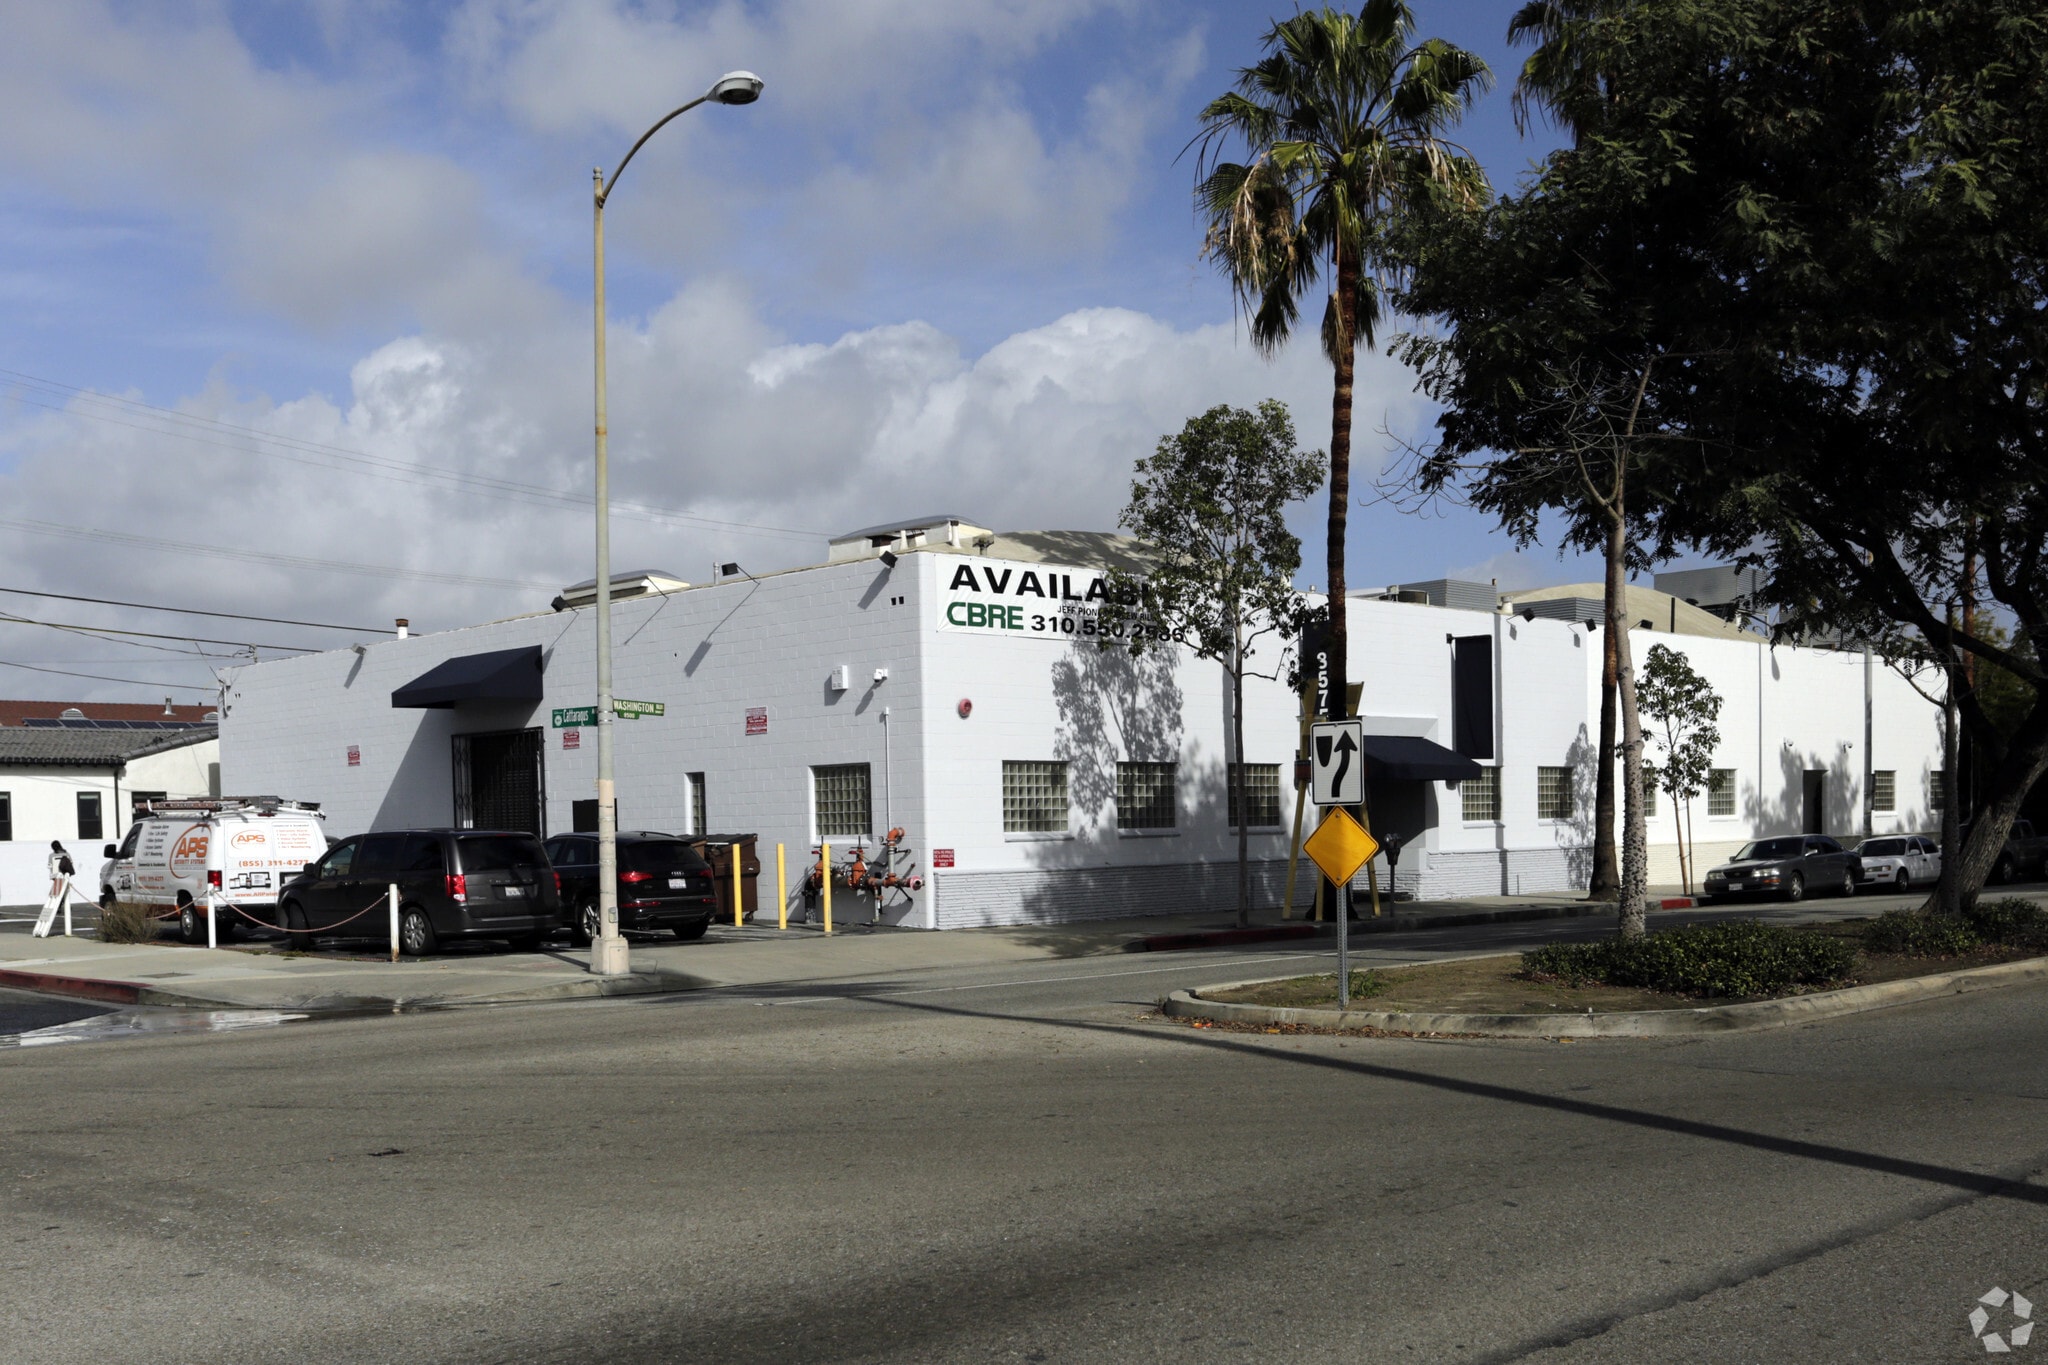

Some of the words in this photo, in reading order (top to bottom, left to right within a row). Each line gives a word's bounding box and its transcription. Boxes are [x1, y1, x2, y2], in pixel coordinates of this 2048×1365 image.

[949, 563, 1183, 611] AVAILAB
[946, 601, 1025, 631] CBRE
[1057, 605, 1076, 615] JEFF
[613, 699, 655, 714] WASHINGTON
[236, 834, 266, 843] APS
[175, 837, 209, 858] APS
[238, 860, 264, 868] (855)
